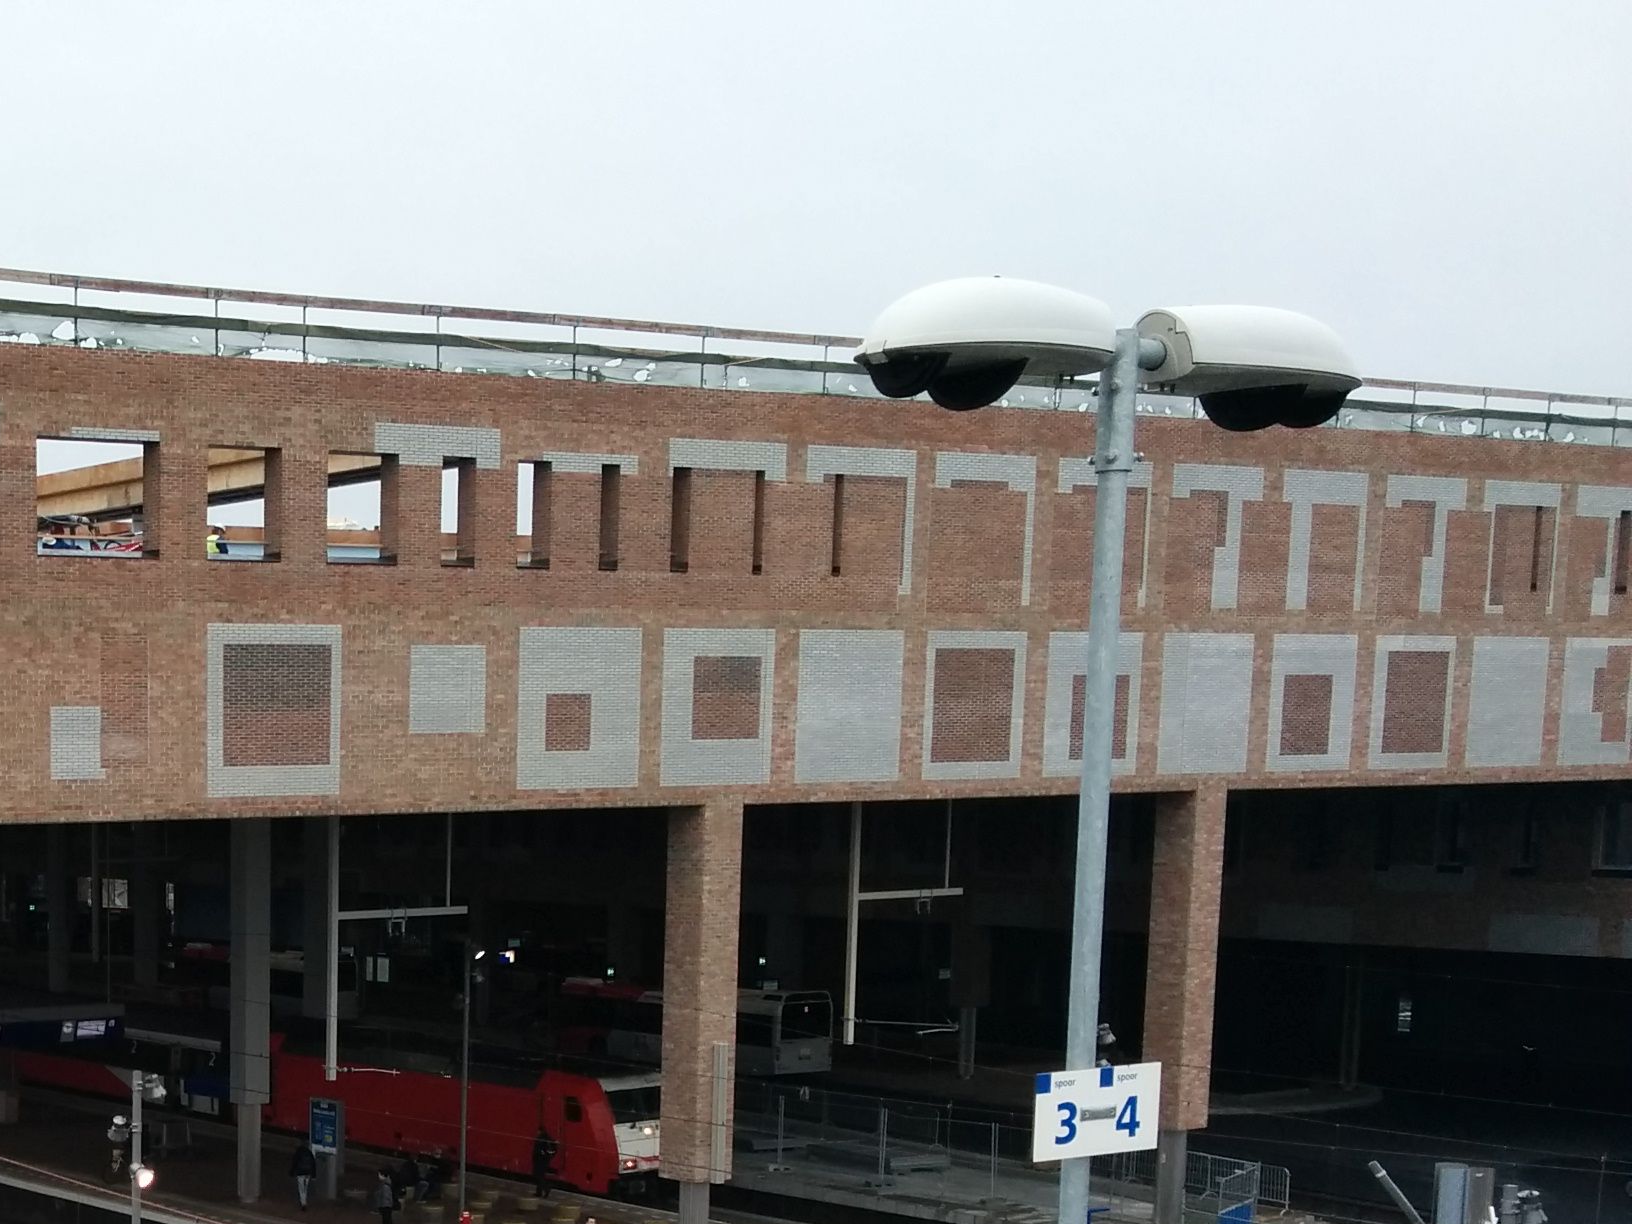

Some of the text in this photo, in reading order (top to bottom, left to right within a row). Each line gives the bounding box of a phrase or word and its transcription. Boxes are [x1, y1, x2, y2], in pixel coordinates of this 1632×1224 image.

[1054, 1072, 1138, 1090] spoor spoor
[1054, 1095, 1140, 1145] 3 4
